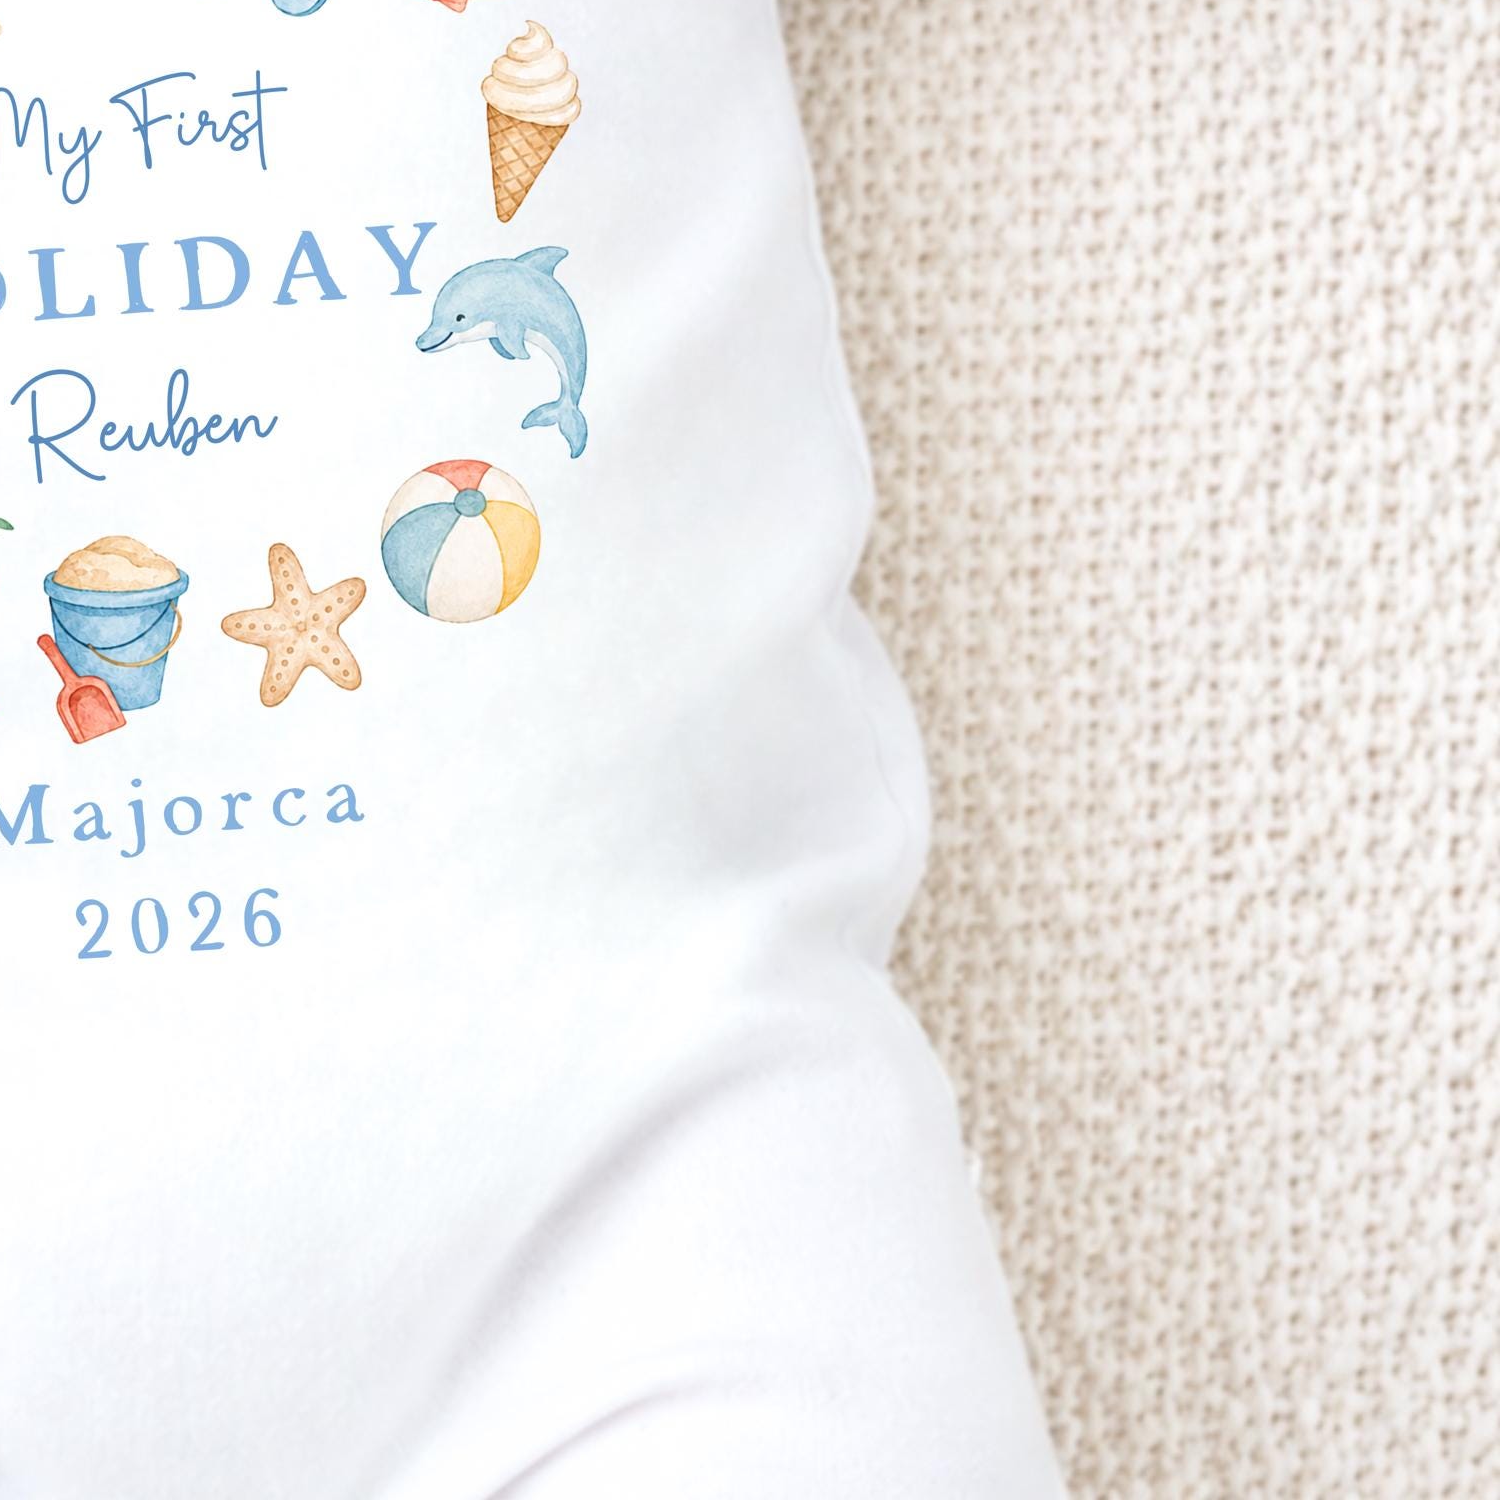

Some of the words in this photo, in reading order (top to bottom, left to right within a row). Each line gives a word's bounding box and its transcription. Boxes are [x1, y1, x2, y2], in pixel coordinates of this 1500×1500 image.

[108, 70, 289, 171] First
[10, 368, 279, 485] Reuben
[75, 888, 282, 960] 2026
